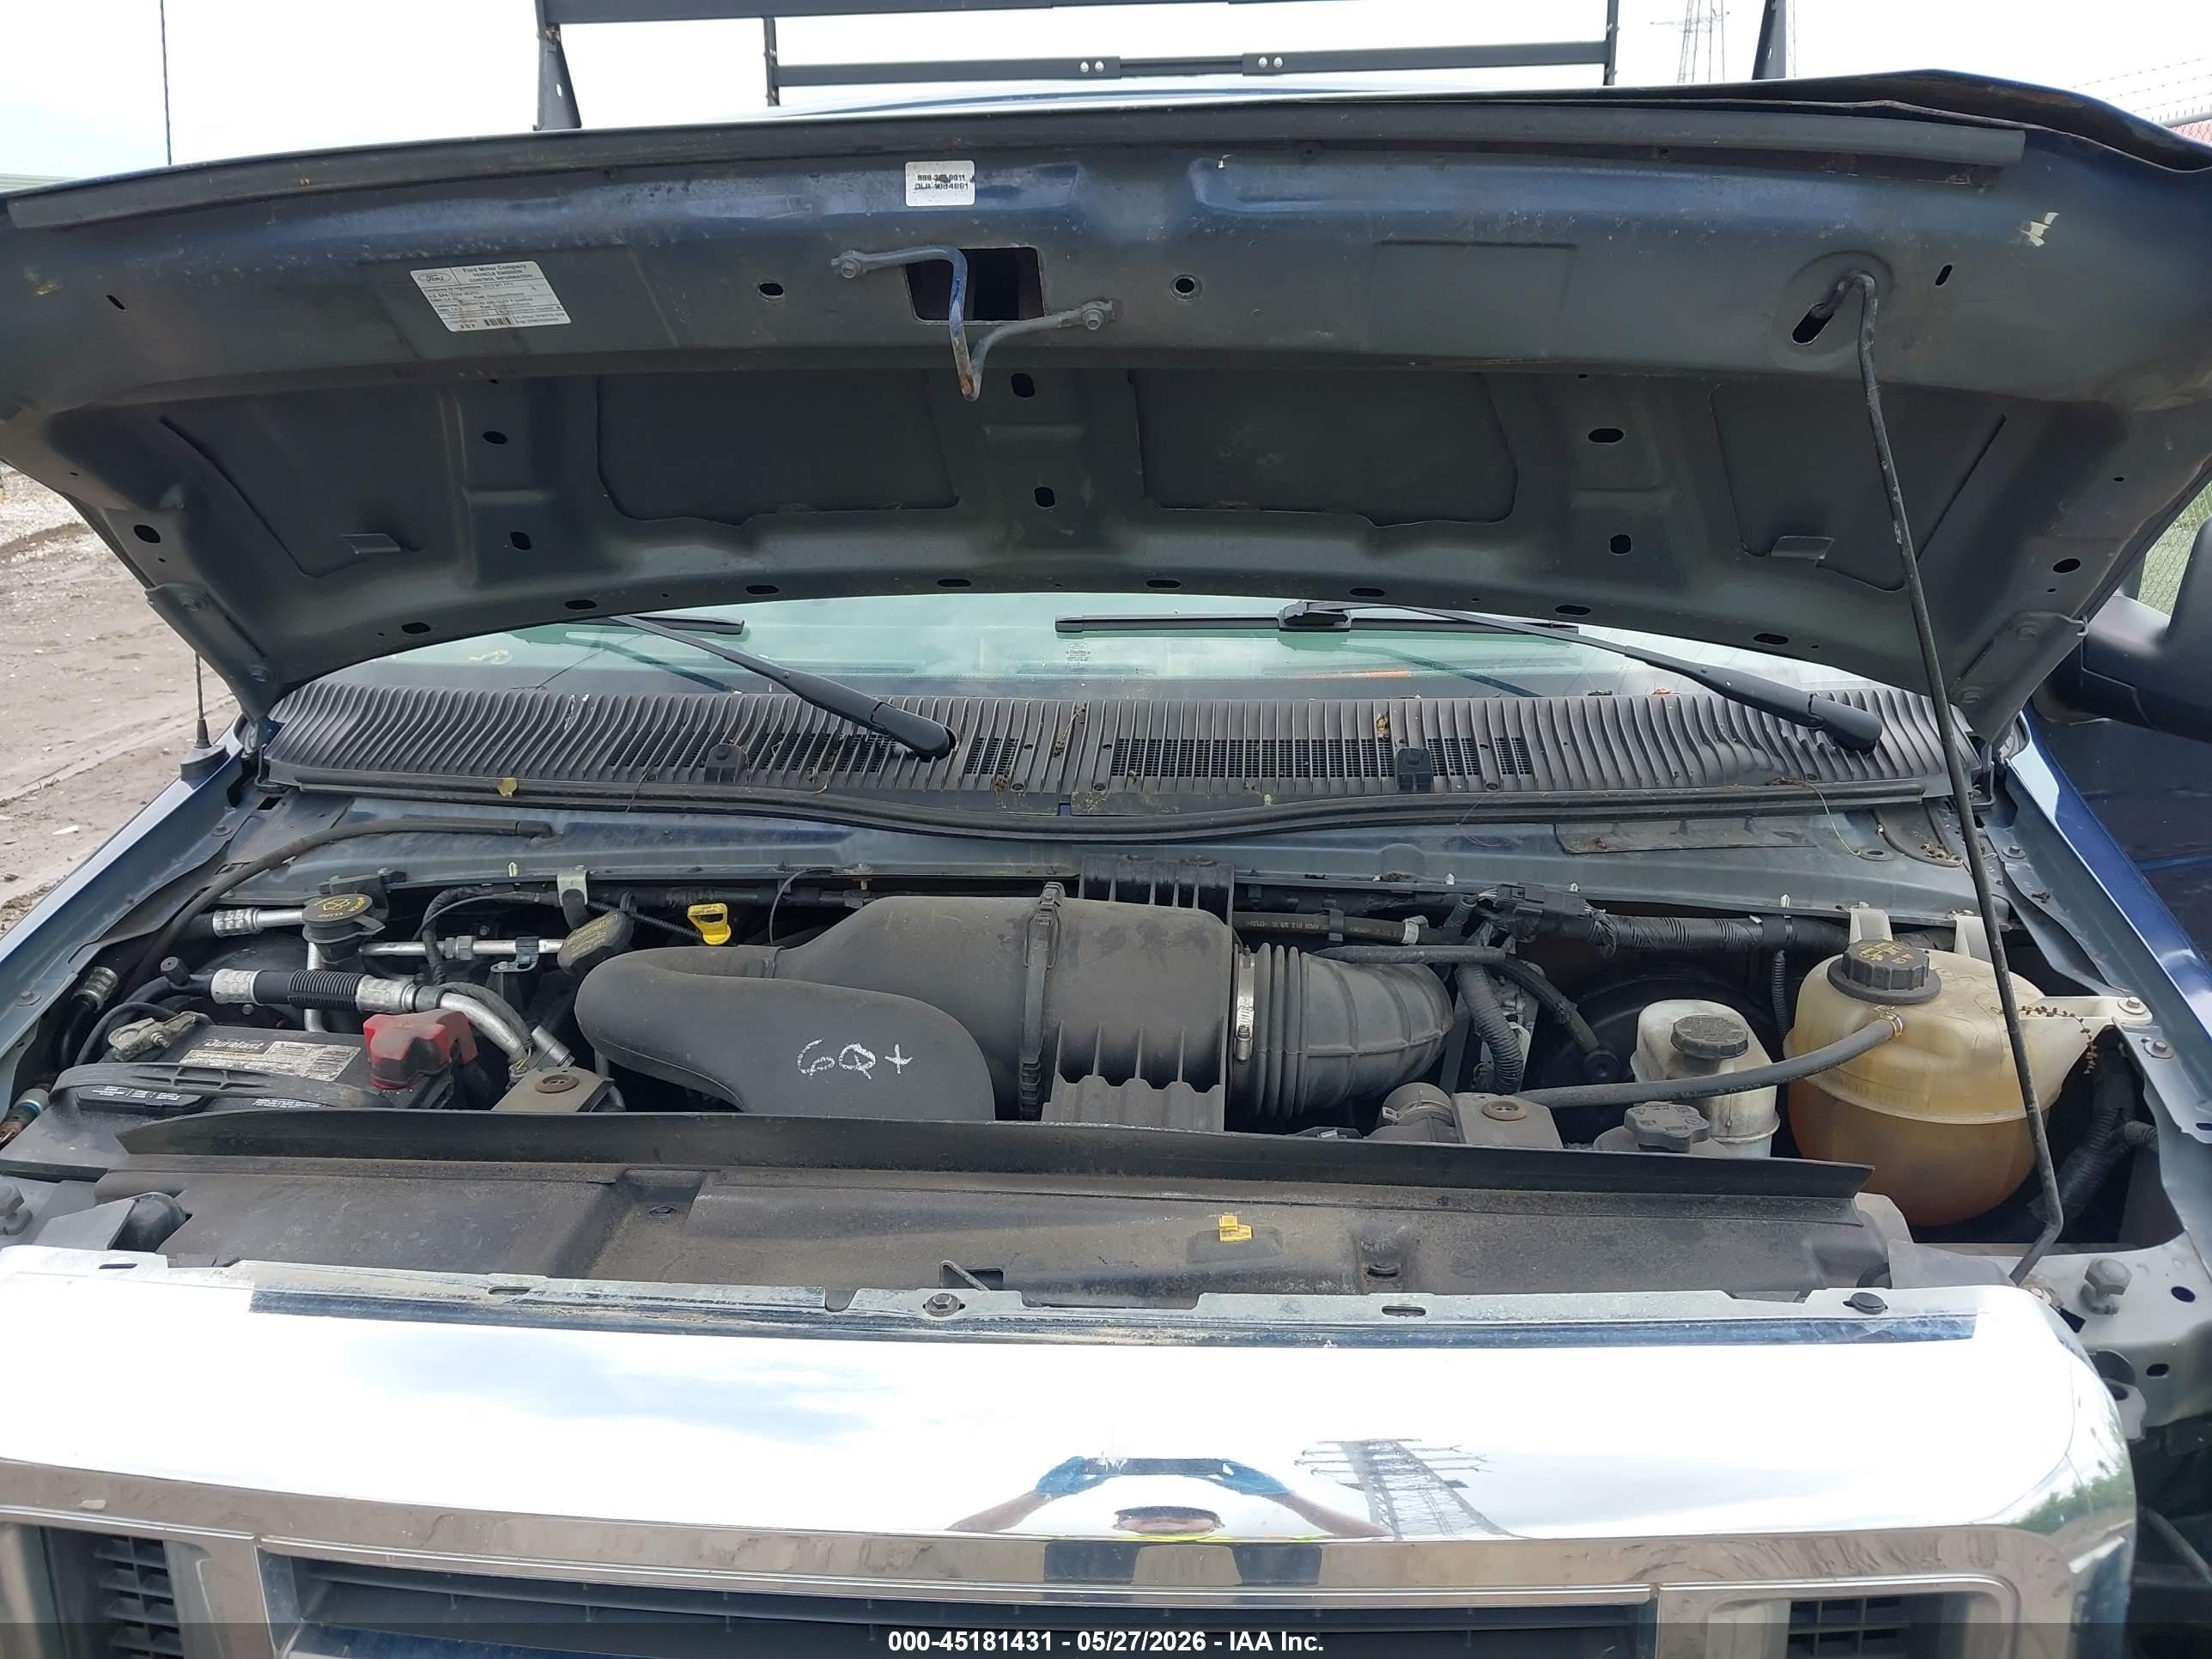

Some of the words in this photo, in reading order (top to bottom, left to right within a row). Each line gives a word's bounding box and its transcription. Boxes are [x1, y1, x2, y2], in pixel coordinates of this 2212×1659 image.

[497, 264, 527, 272] Company
[425, 273, 445, 283] Ford
[204, 1039, 265, 1050] Duralast
